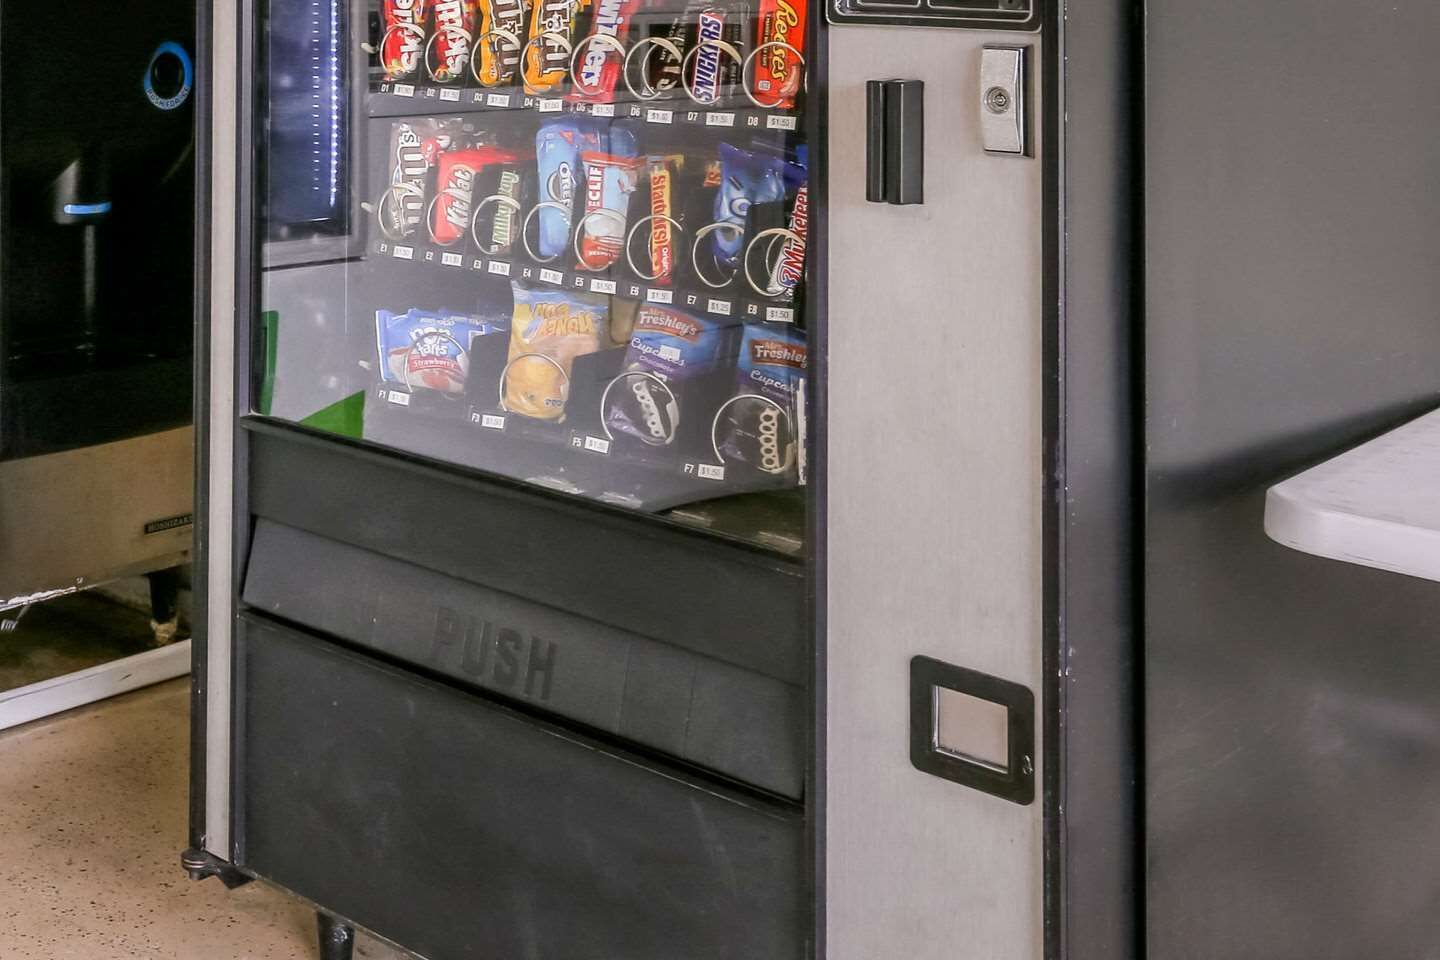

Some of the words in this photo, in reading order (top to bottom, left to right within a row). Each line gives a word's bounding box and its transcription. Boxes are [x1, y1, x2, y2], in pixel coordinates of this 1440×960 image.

[771, 0, 798, 83] Reese's
[524, 97, 533, 107] D4
[631, 106, 640, 116] D6
[688, 111, 698, 121] D7
[748, 116, 758, 127] D8
[523, 268, 531, 278] E4
[687, 295, 697, 305] E7
[640, 311, 697, 336] Freshley's
[750, 369, 793, 392] Cupca
[684, 463, 694, 474] F7
[431, 605, 558, 701] PUSH
